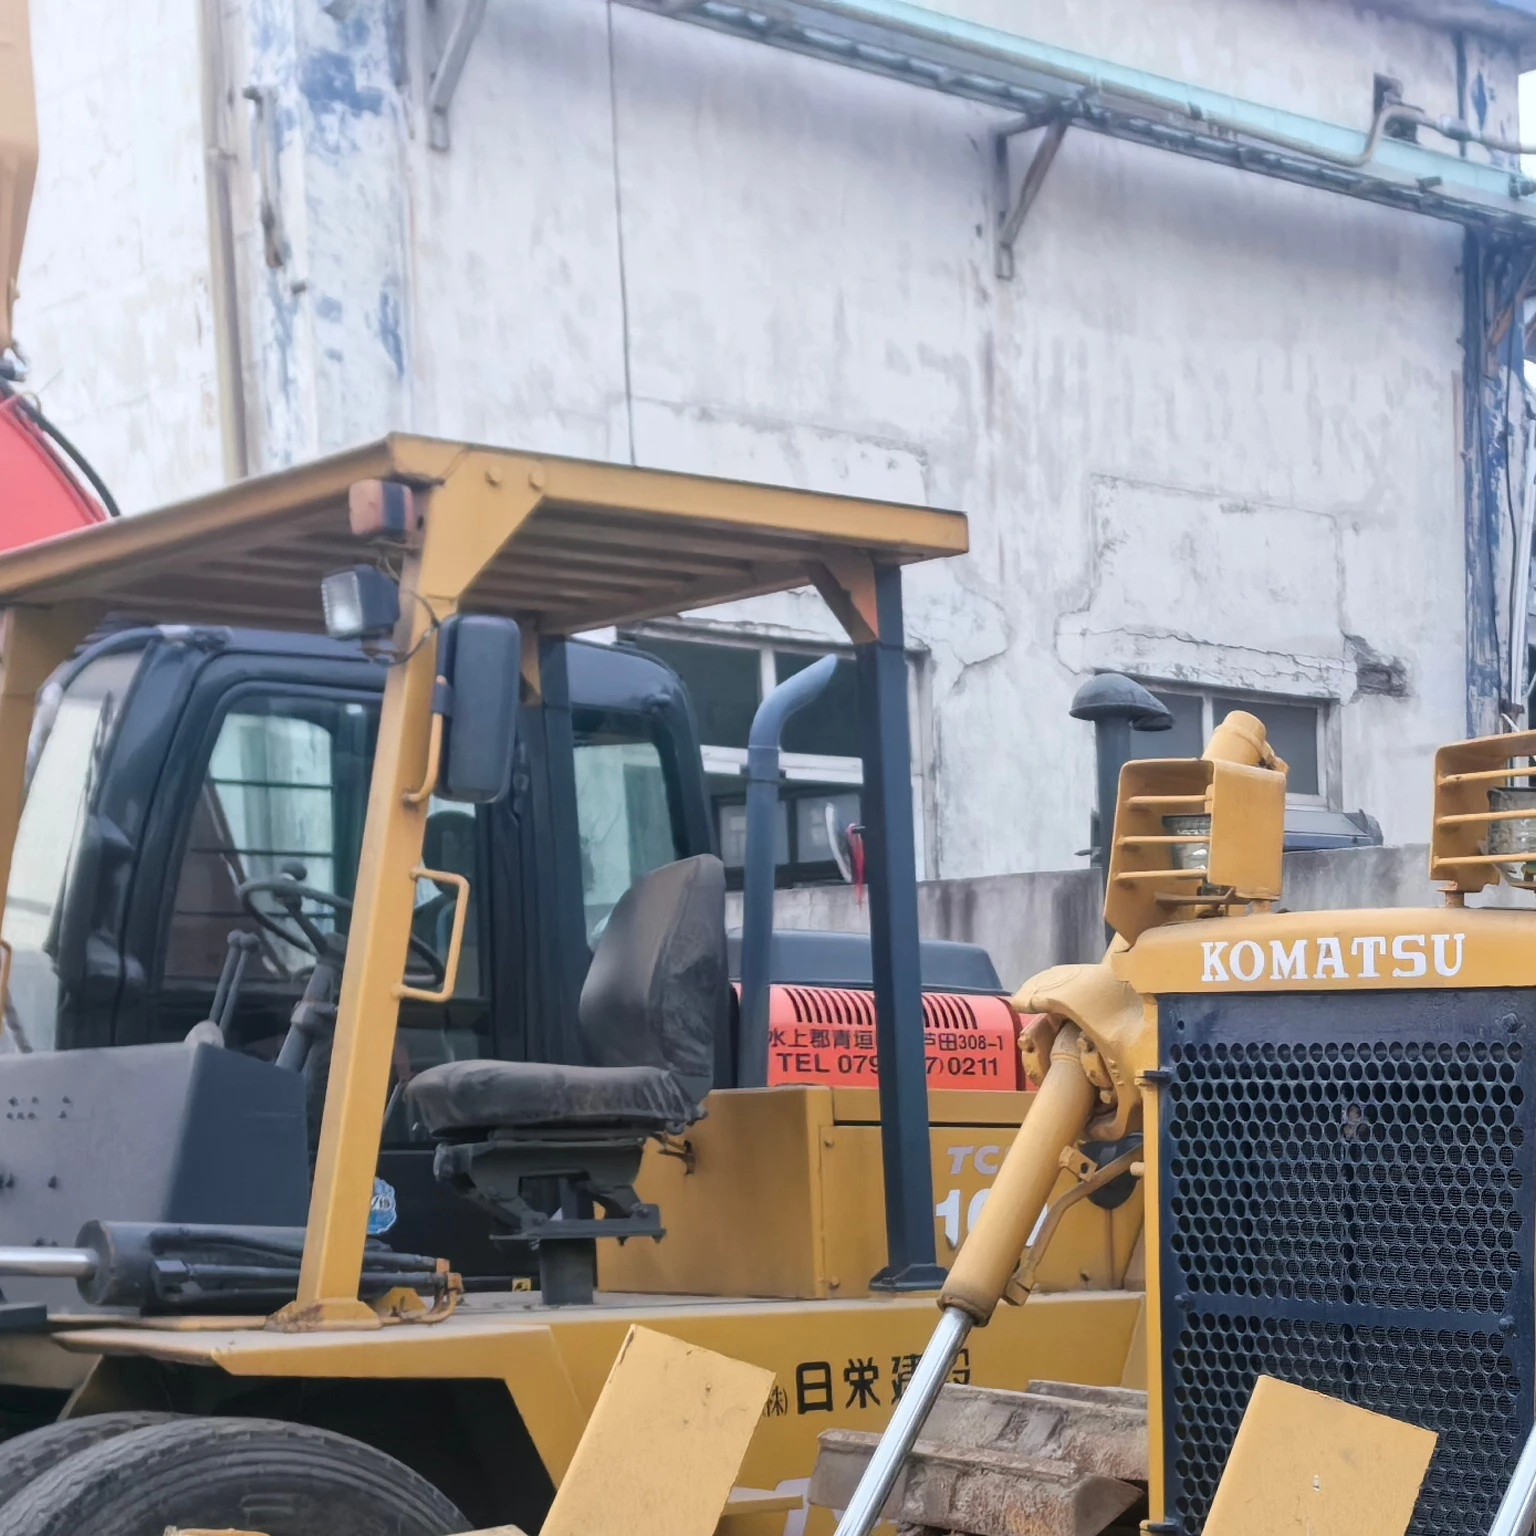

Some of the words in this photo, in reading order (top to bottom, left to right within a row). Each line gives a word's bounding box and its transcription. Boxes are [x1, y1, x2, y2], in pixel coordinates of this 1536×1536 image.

[1200, 933, 1466, 982] KOMATSU
[776, 1052, 830, 1073] TEL
[947, 1145, 1012, 1175] TC
